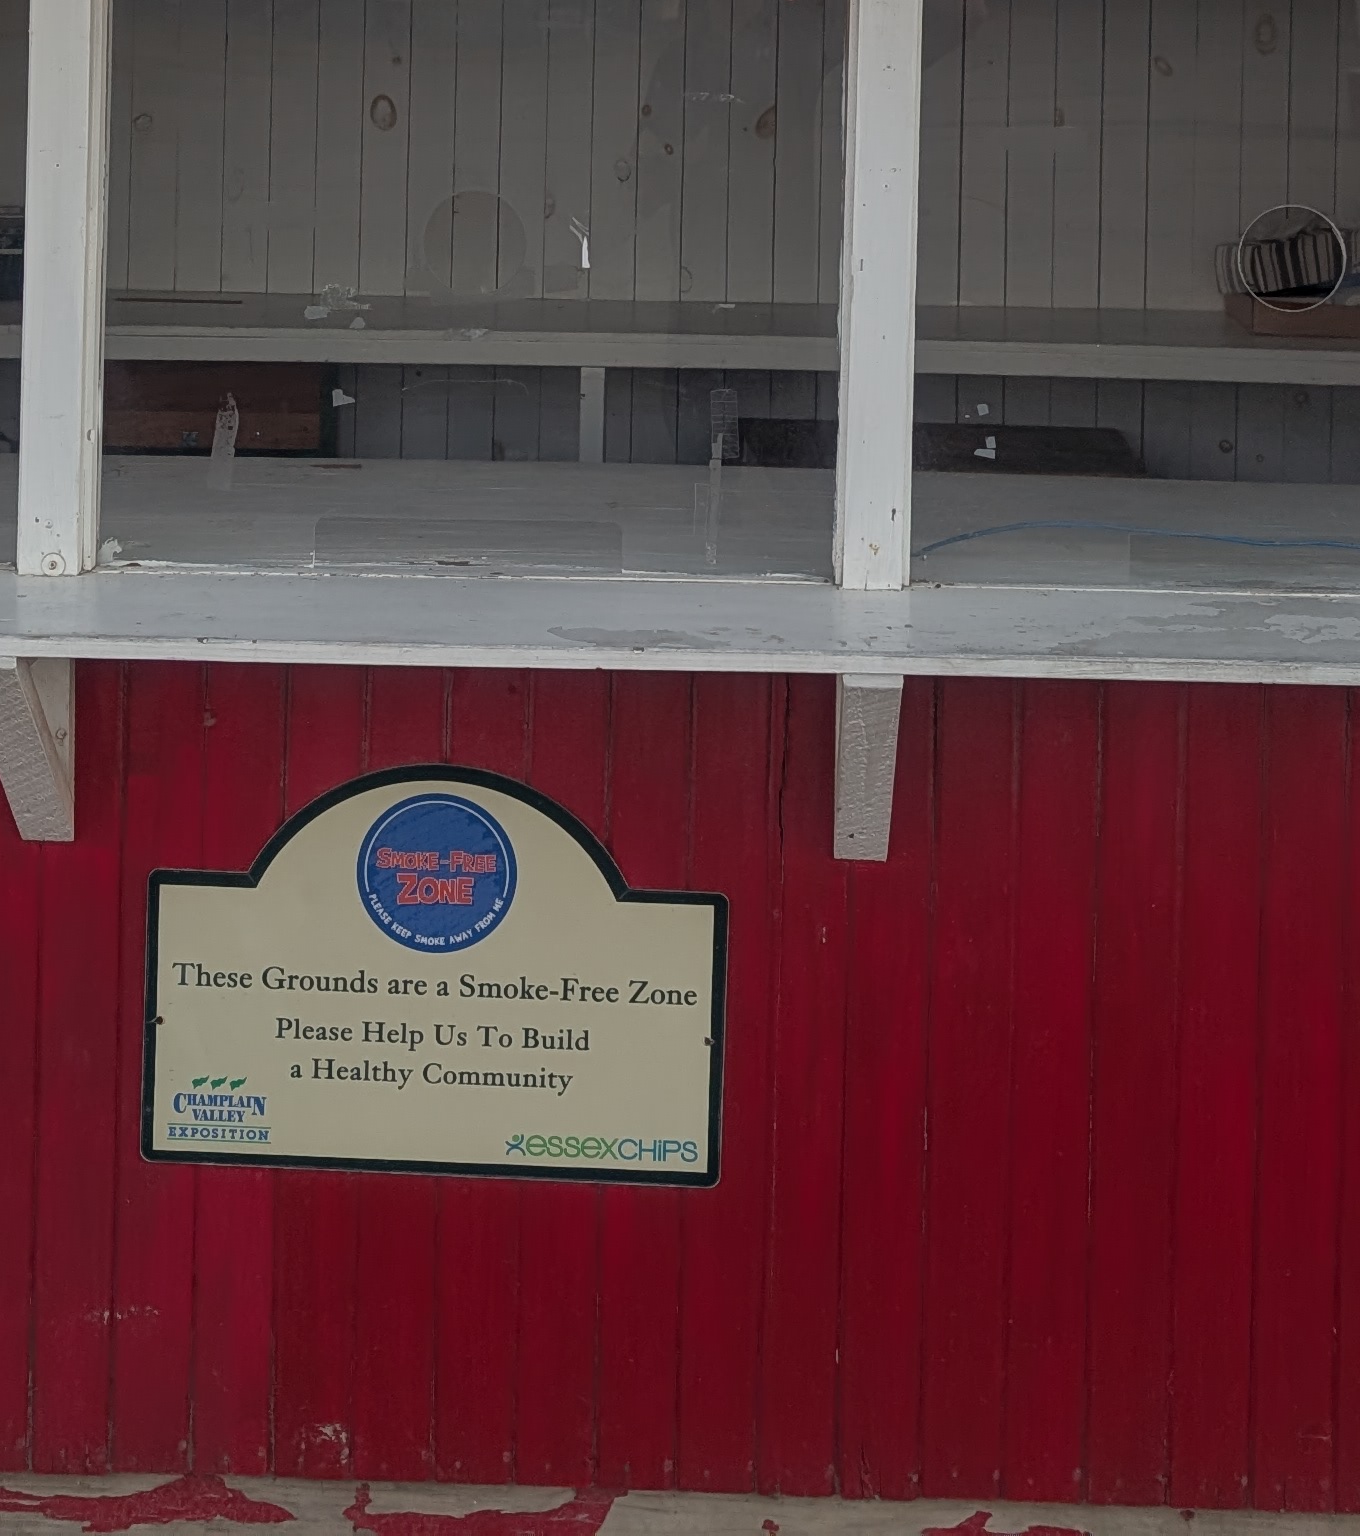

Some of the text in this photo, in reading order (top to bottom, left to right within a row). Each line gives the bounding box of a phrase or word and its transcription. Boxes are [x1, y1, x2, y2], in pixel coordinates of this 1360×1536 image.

[376, 847, 497, 874] SMOKE-FREE
[396, 872, 475, 905] ZONE
[368, 893, 505, 946] PLEASE KEEP SMOKE AWAY FROM ME
[172, 962, 698, 1006] These Grounds are a Smoke-Free Zone
[274, 1017, 590, 1052] Please Help Us To Build
[290, 1057, 574, 1097] a Healthy Community
[173, 1092, 267, 1116] CHAMPLAIN
[192, 1108, 246, 1123] VALLEY
[168, 1126, 269, 1141] EXPOSITION
